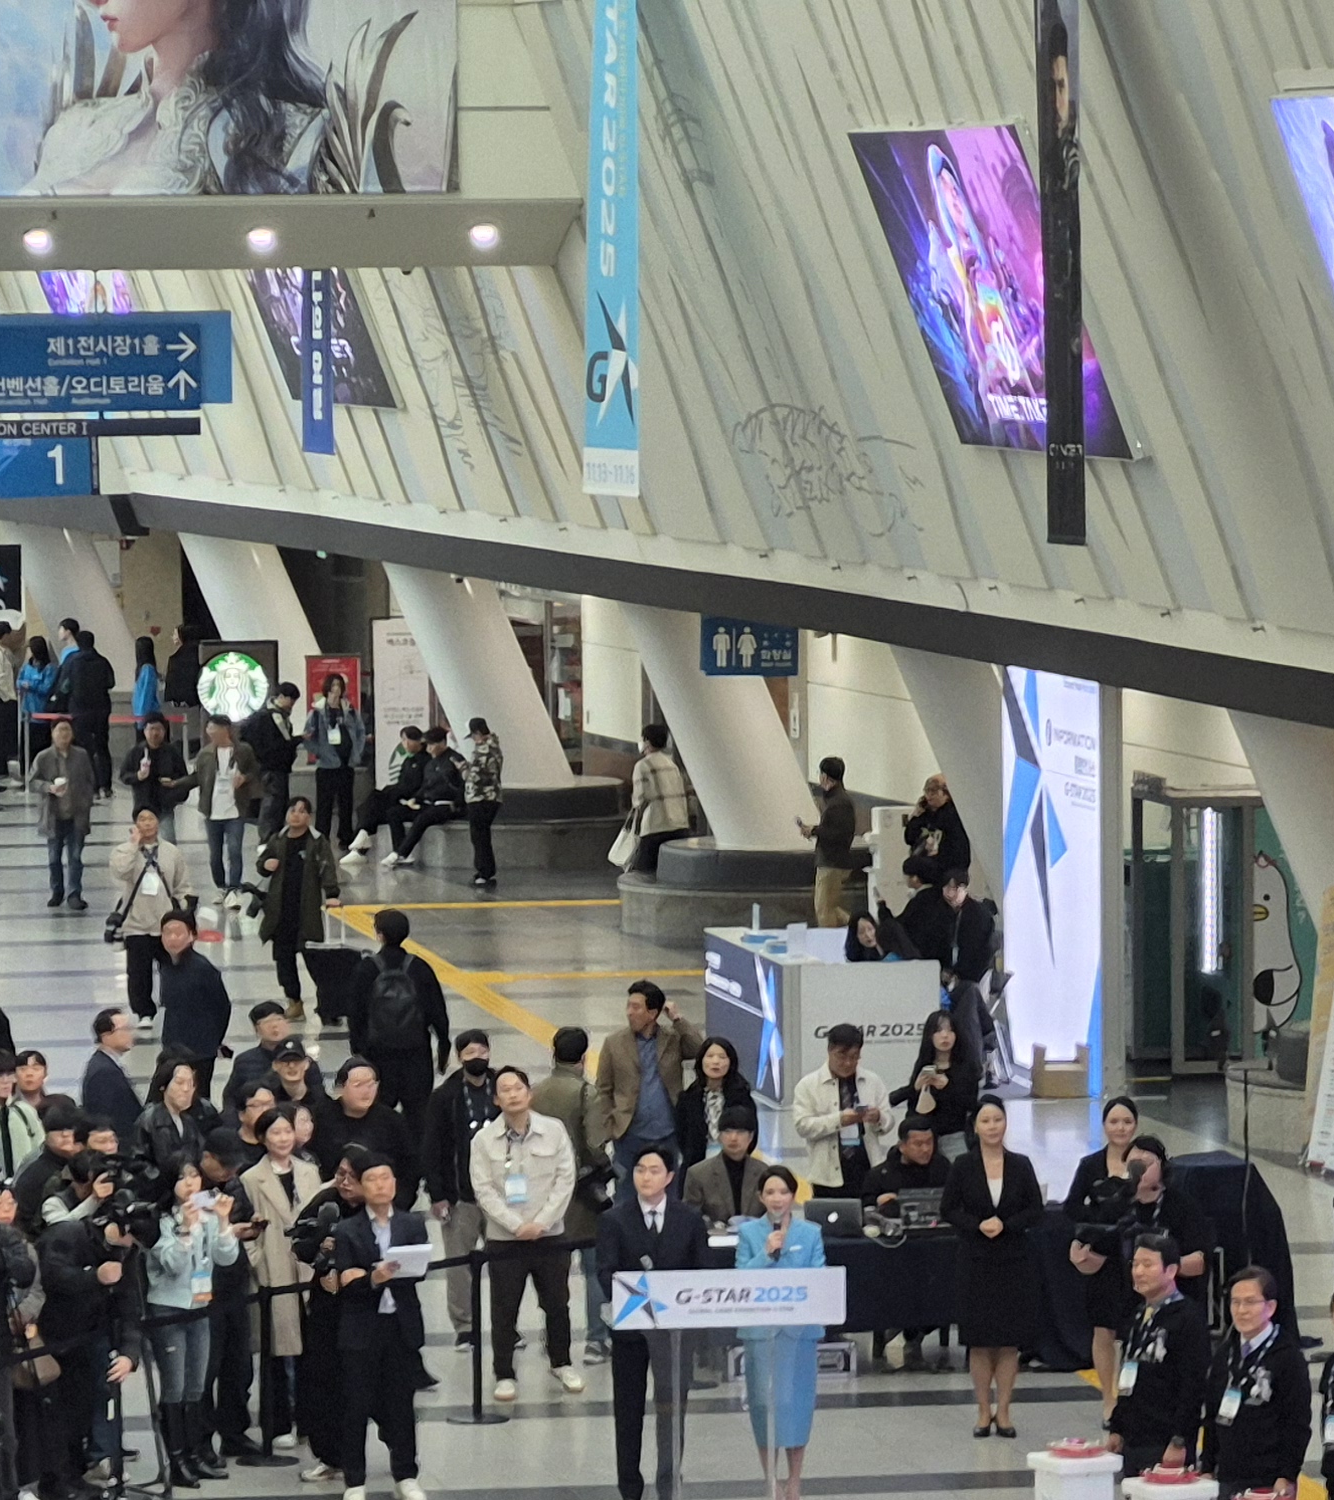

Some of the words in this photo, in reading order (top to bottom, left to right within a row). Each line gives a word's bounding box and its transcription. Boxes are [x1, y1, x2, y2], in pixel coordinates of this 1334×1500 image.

[600, 115, 616, 277] 2025
[47, 335, 160, 357] 제1전시장1홀
[22, 422, 77, 436] CENTER
[47, 444, 64, 485] 1
[760, 649, 791, 661] 화장실
[675, 1286, 751, 1306] G-STAR
[752, 1285, 808, 1303] 2025
